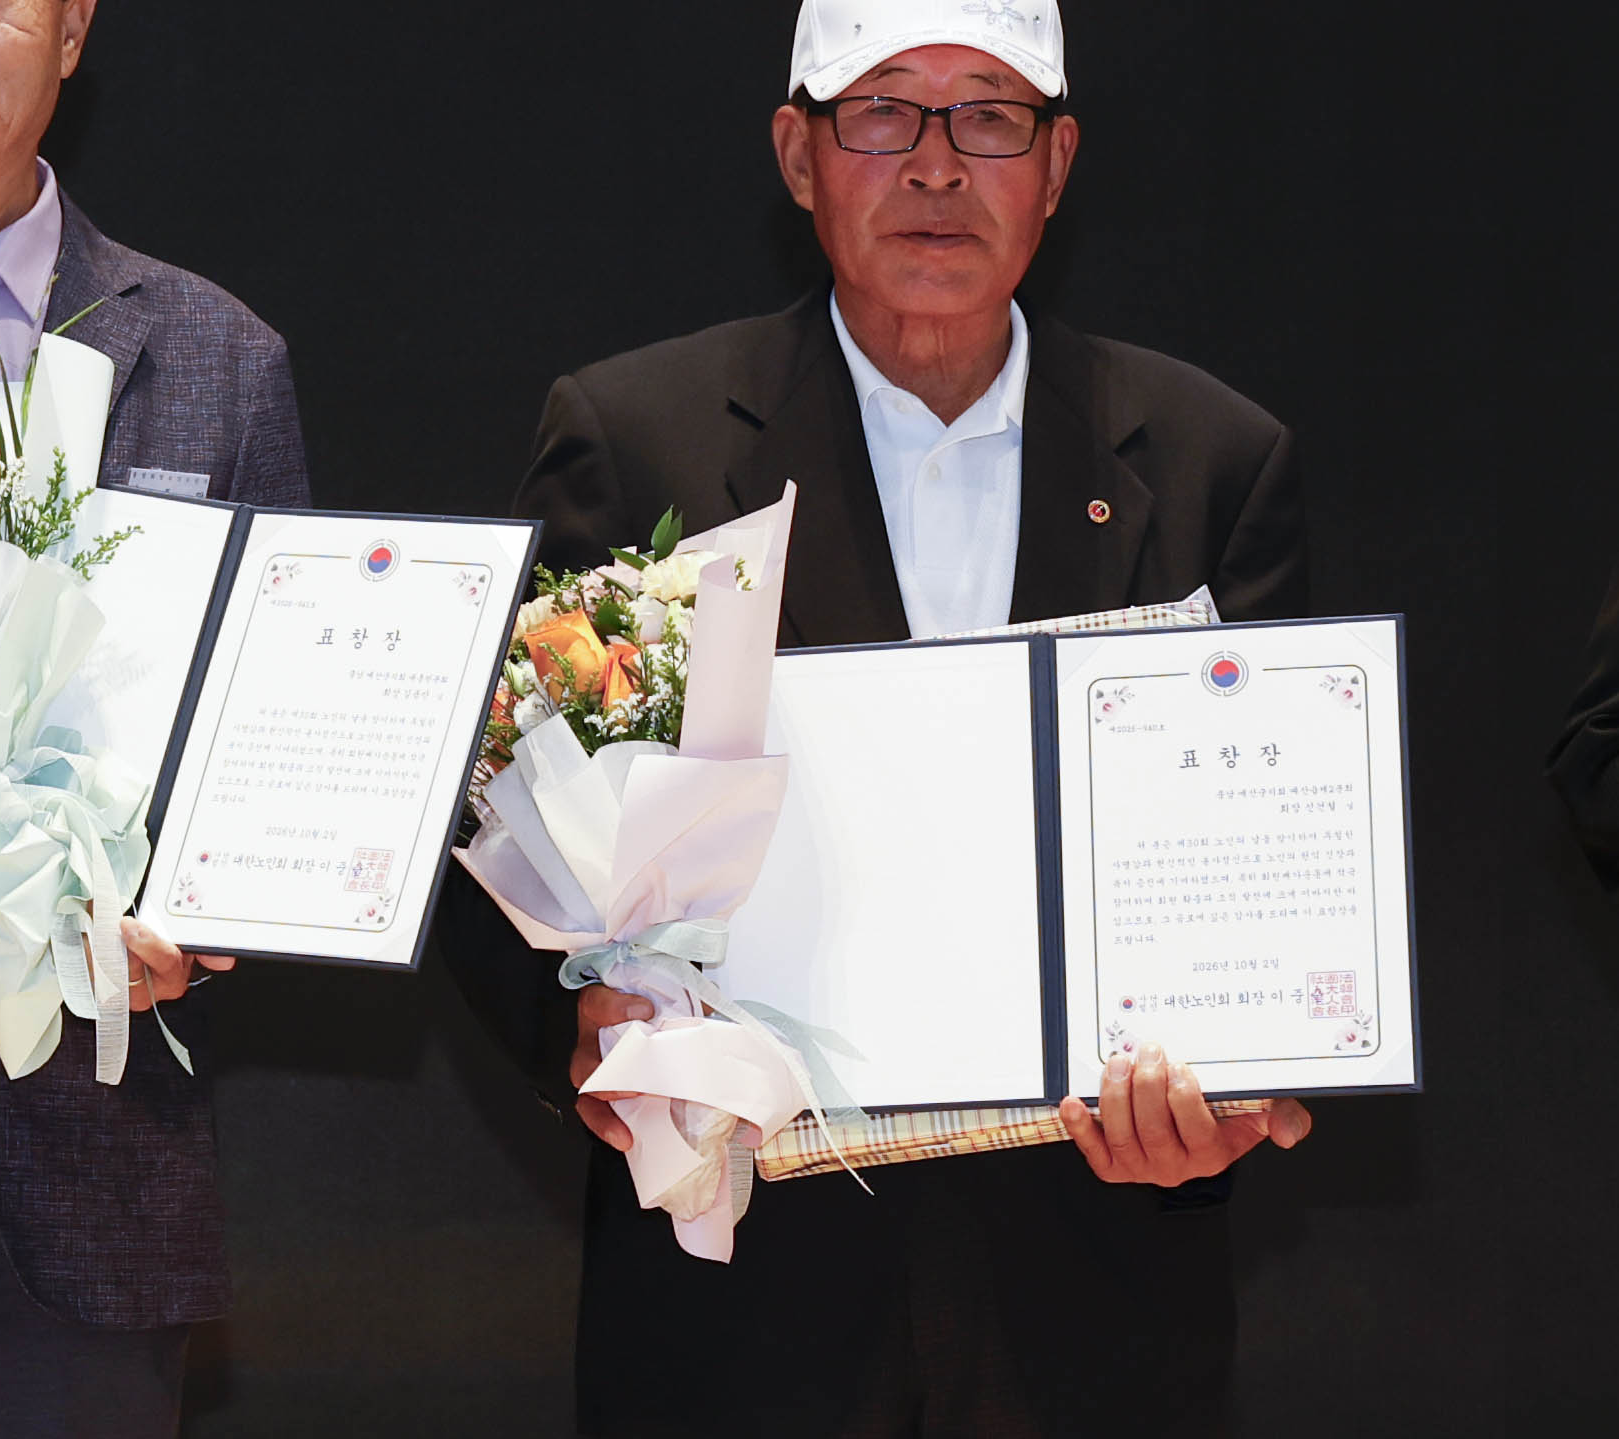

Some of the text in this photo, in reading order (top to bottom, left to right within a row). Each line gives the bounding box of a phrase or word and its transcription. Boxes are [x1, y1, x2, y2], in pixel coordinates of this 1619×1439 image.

[289, 856, 317, 874] 회장
[1192, 957, 1280, 972] 2026년 10월 2일
[1164, 990, 1230, 1010] 대한노인회
[1237, 989, 1265, 1007] 회장
